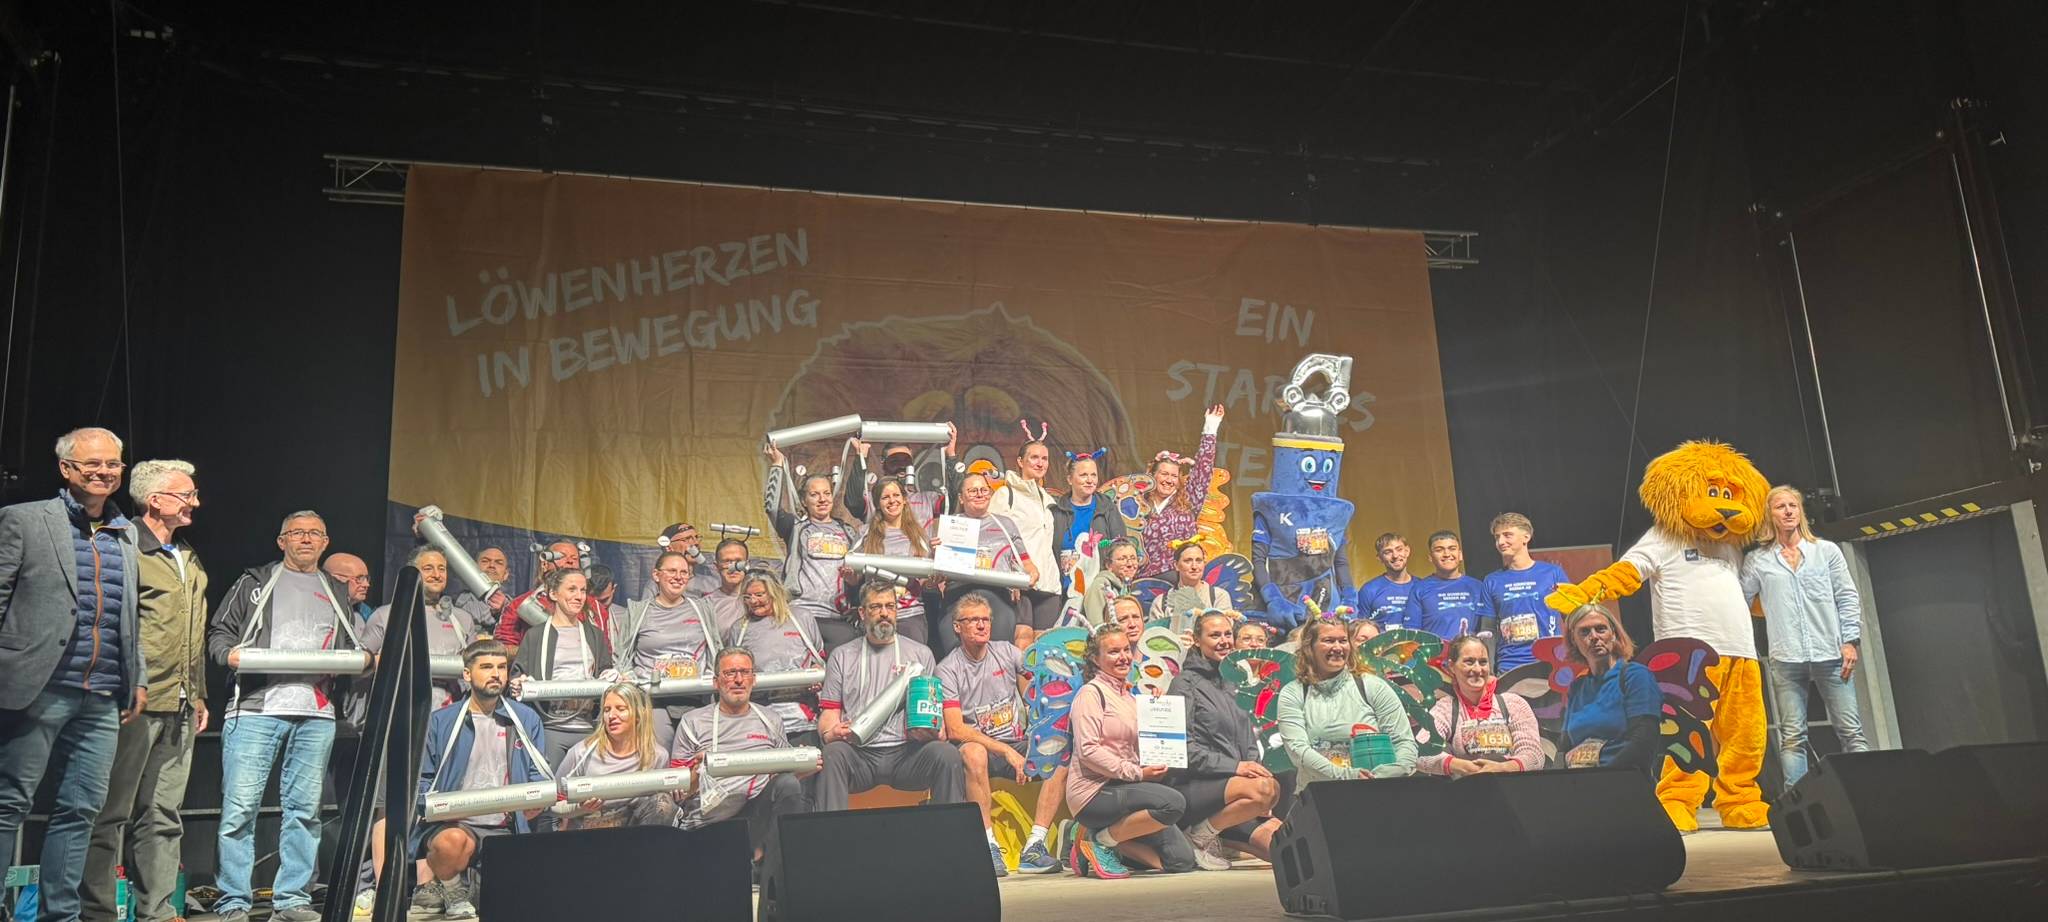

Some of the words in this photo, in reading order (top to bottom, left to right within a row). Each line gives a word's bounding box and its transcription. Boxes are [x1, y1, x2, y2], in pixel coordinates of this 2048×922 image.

[446, 228, 809, 337] LÖWENHERZEN
[477, 345, 530, 398] IN
[550, 289, 821, 382] BEWEGUNG
[1235, 297, 1316, 347] EIN
[1166, 359, 1377, 432] STARS
[1280, 512, 1294, 527] K
[676, 666, 694, 676] 179
[1483, 733, 1510, 745] 1630
